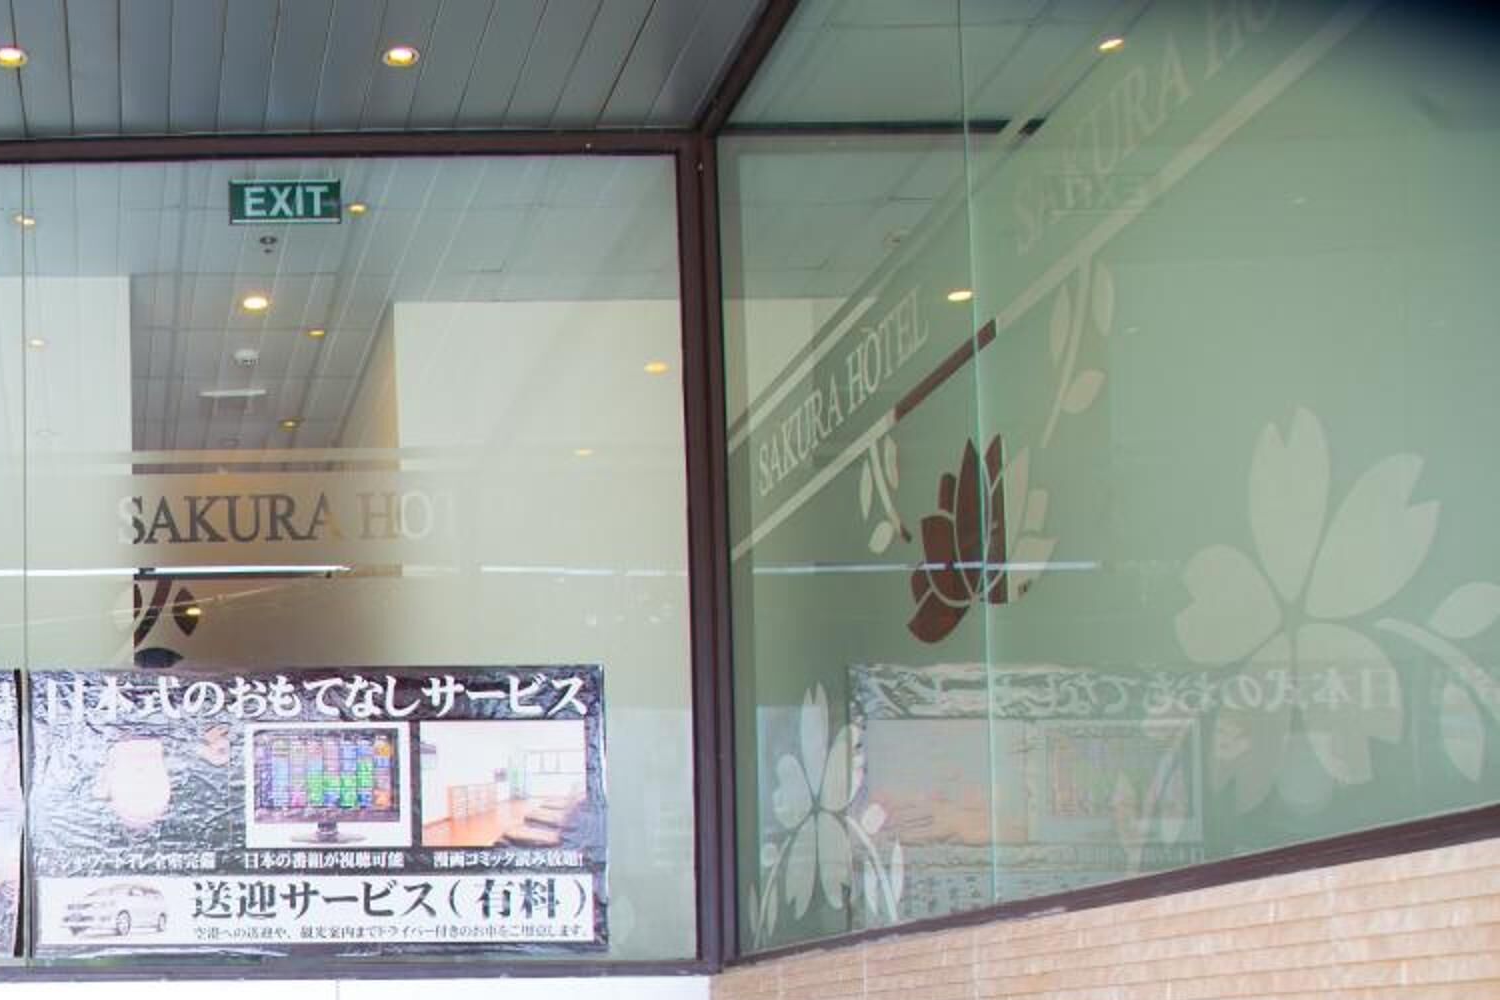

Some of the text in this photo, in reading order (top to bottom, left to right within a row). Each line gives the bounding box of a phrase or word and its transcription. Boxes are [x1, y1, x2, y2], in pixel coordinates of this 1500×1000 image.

[244, 186, 329, 217] EXIT
[758, 284, 930, 497] SAKURA HOTEL
[118, 491, 344, 543] SAKURA
[46, 674, 588, 719] 日本式のおもてなしサービス
